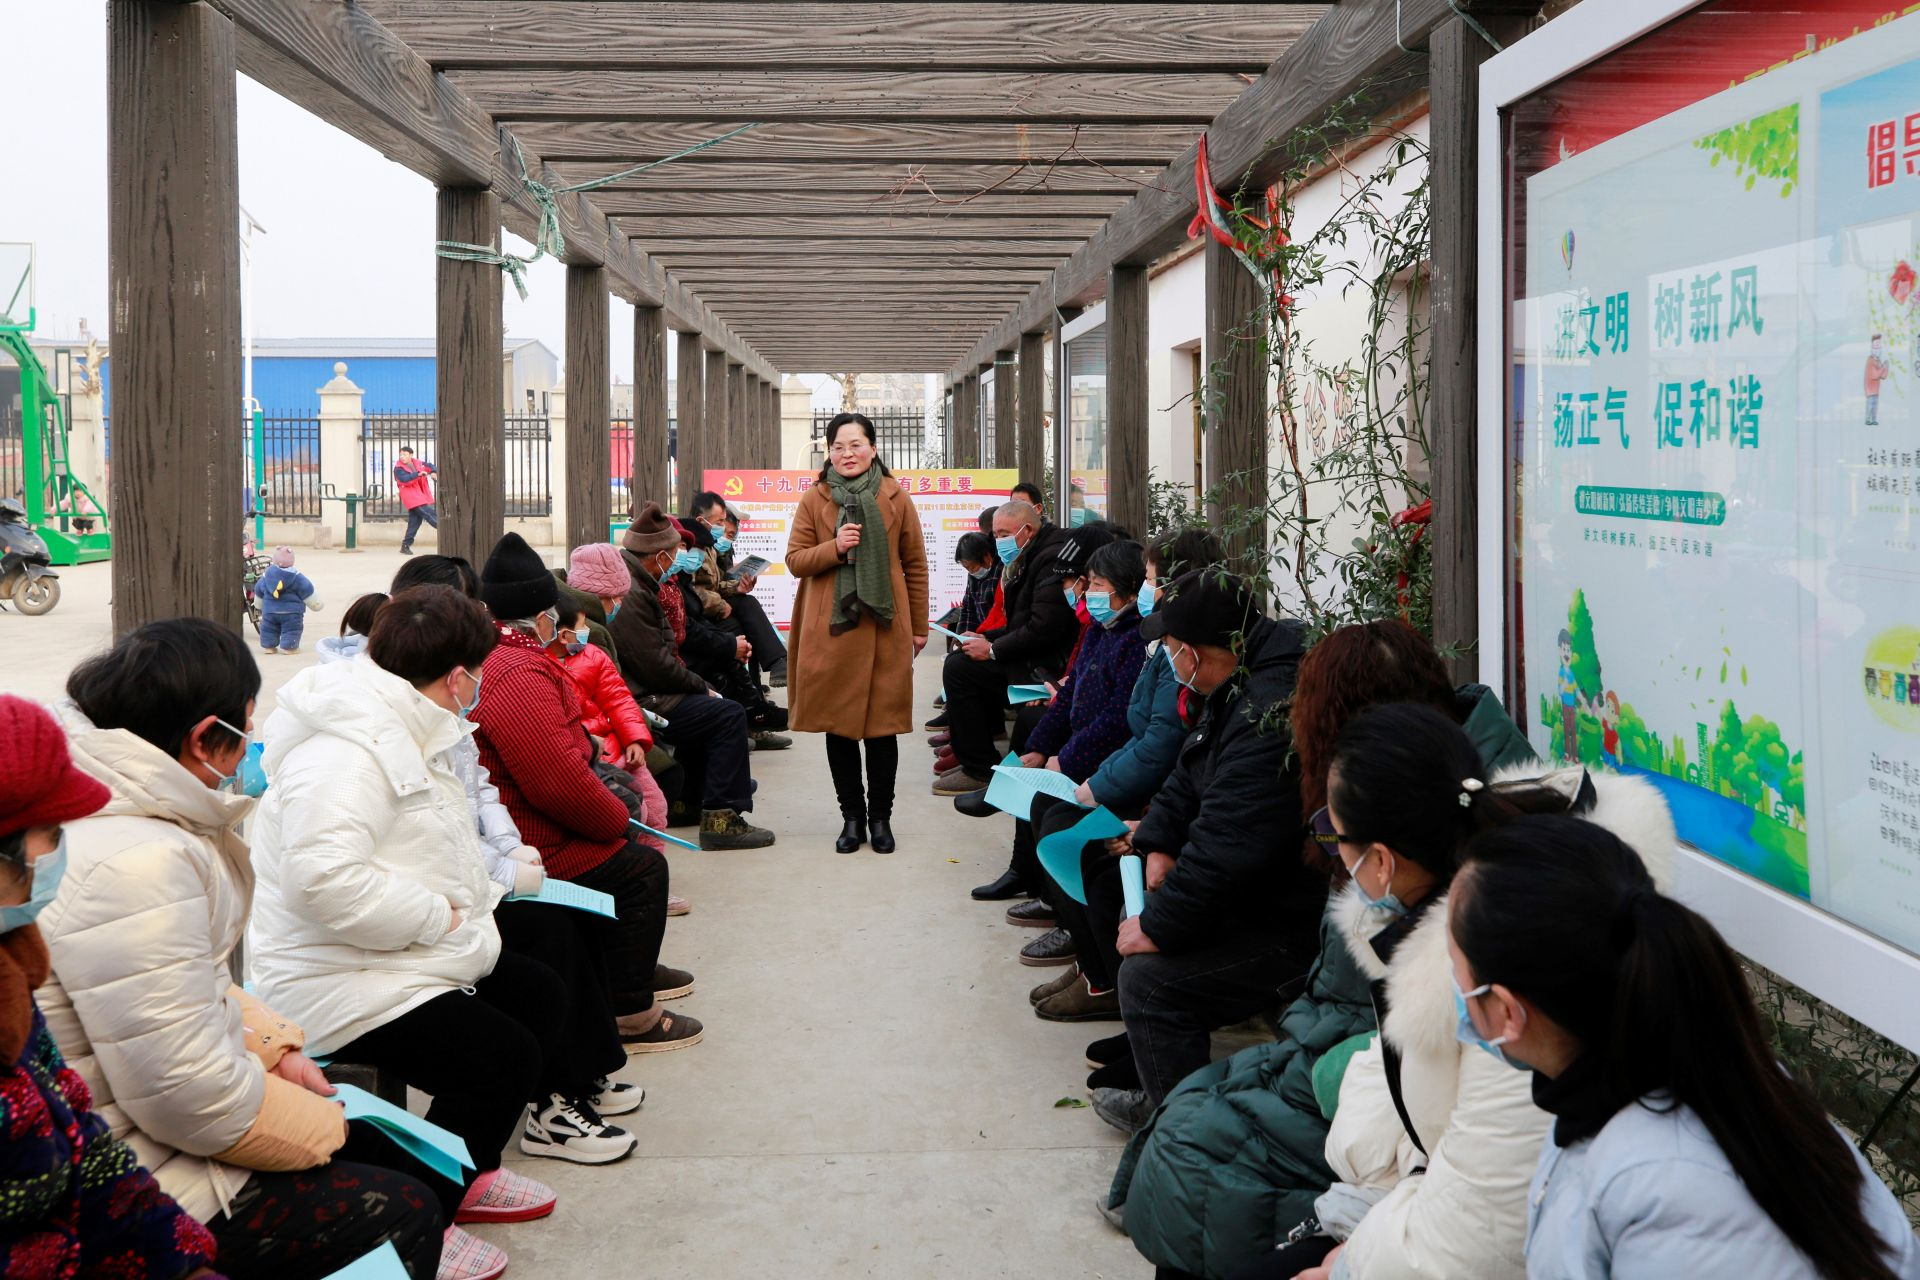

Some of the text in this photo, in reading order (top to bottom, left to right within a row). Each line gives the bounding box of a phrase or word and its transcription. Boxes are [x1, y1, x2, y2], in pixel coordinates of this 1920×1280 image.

[1554, 265, 1764, 360] 讲文明 树新风
[1554, 374, 1763, 450] 扬正气 促和谐
[757, 476, 973, 493] 十九届 有多重要
